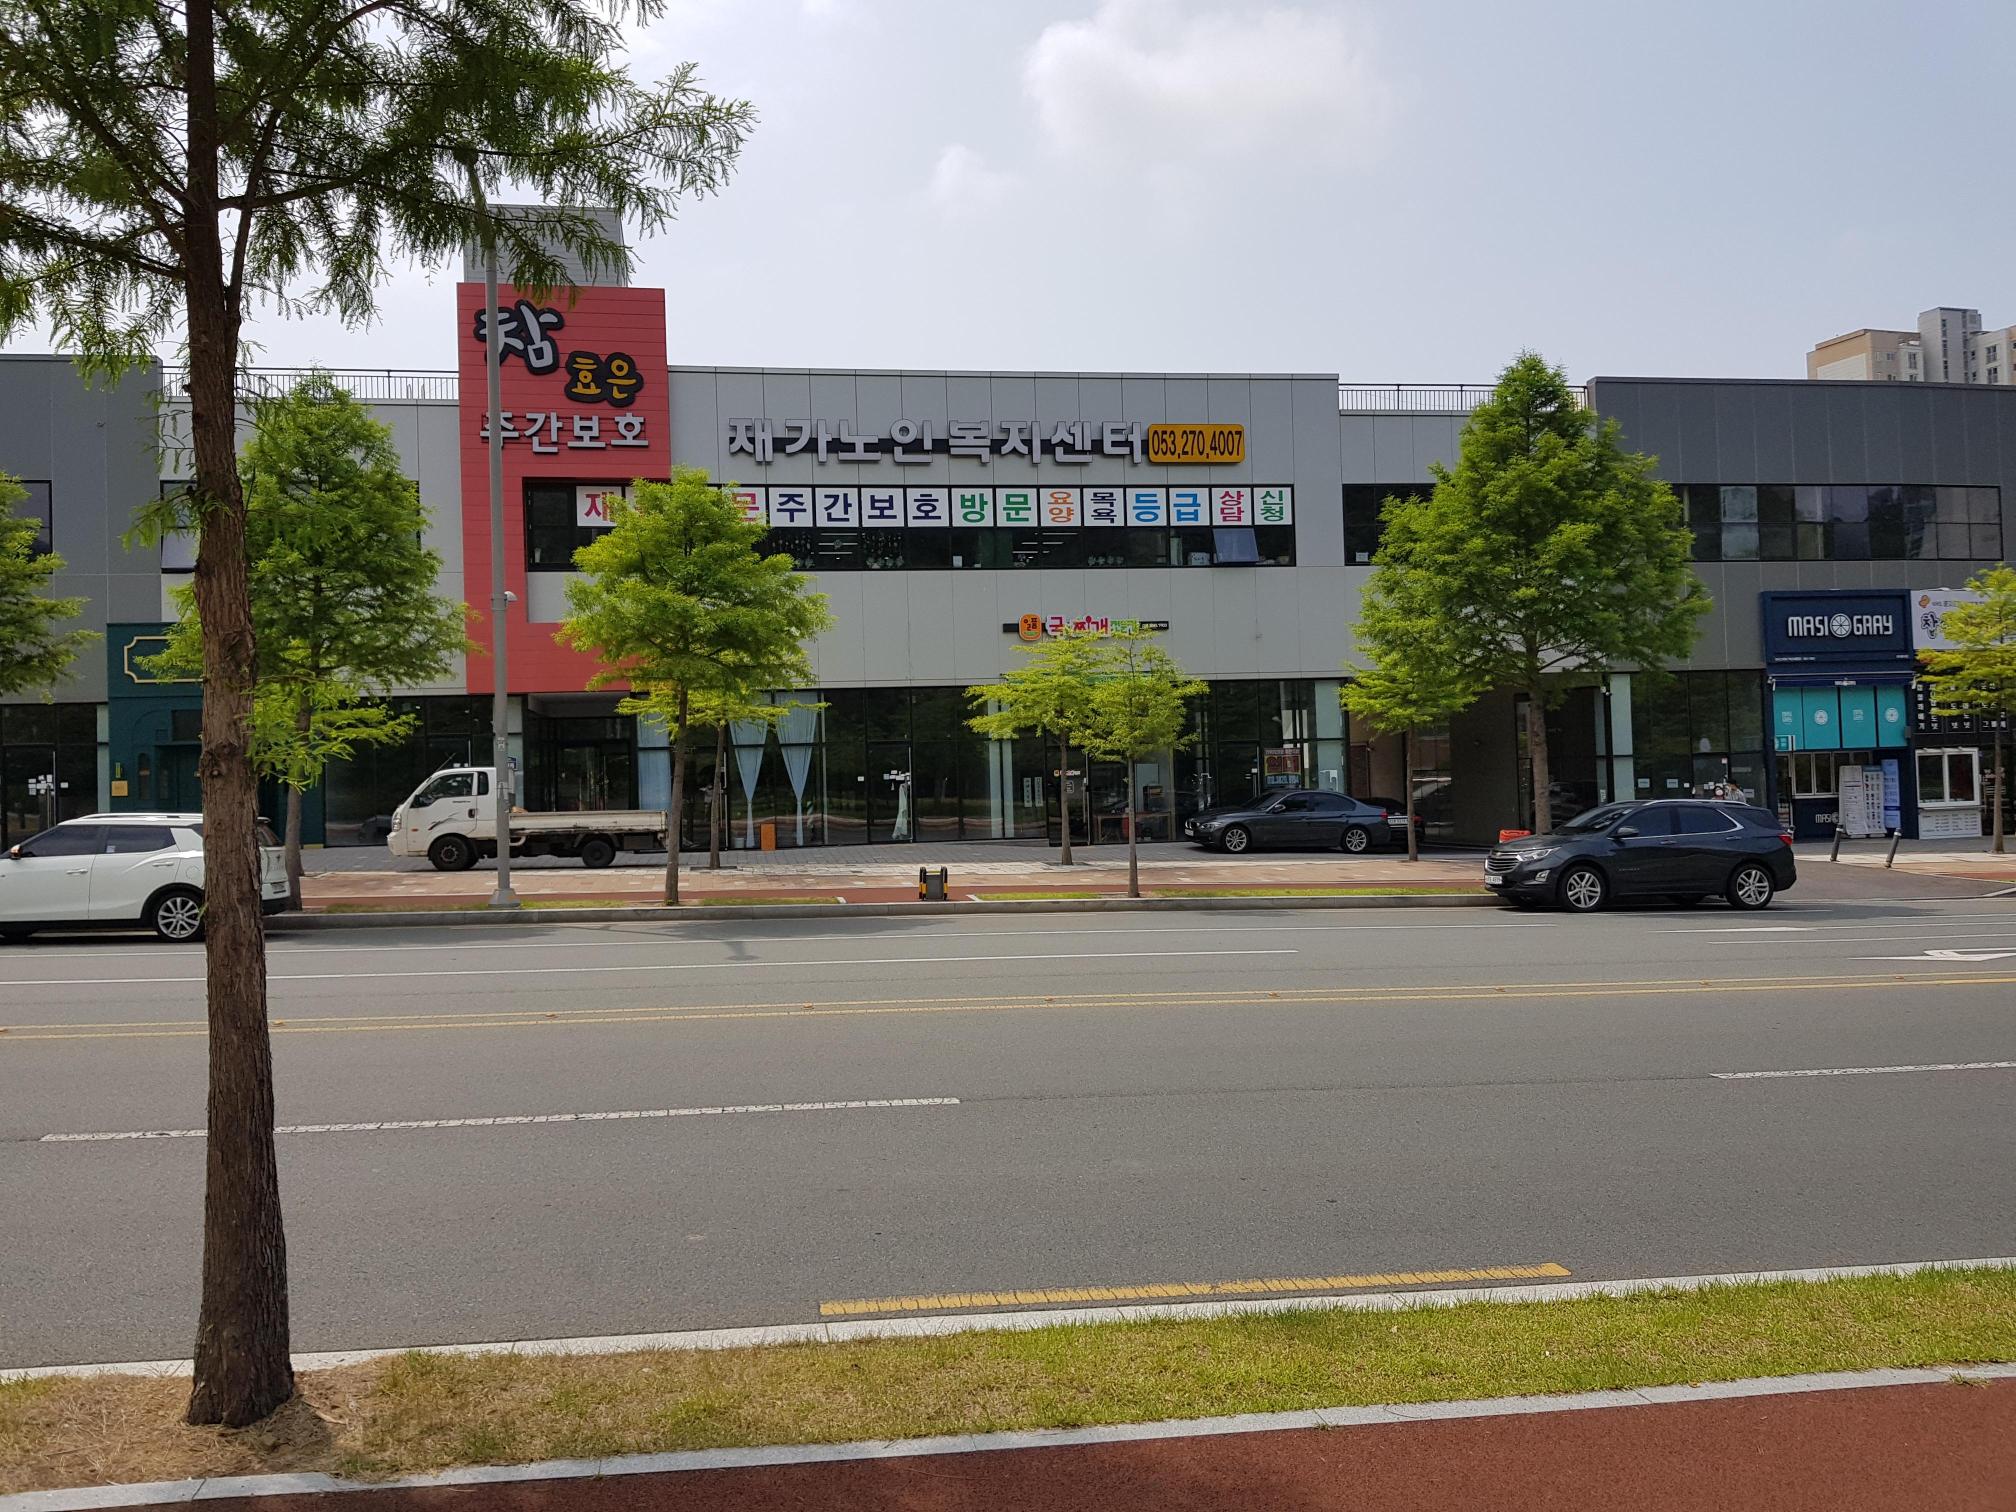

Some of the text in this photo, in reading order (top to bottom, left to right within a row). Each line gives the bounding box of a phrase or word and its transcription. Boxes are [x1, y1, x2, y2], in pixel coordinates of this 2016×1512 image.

[567, 352, 642, 405] 효은
[480, 411, 649, 453] 주간보호
[729, 418, 1143, 464] 재가노인복지센터
[1787, 616, 1829, 637] MASI
